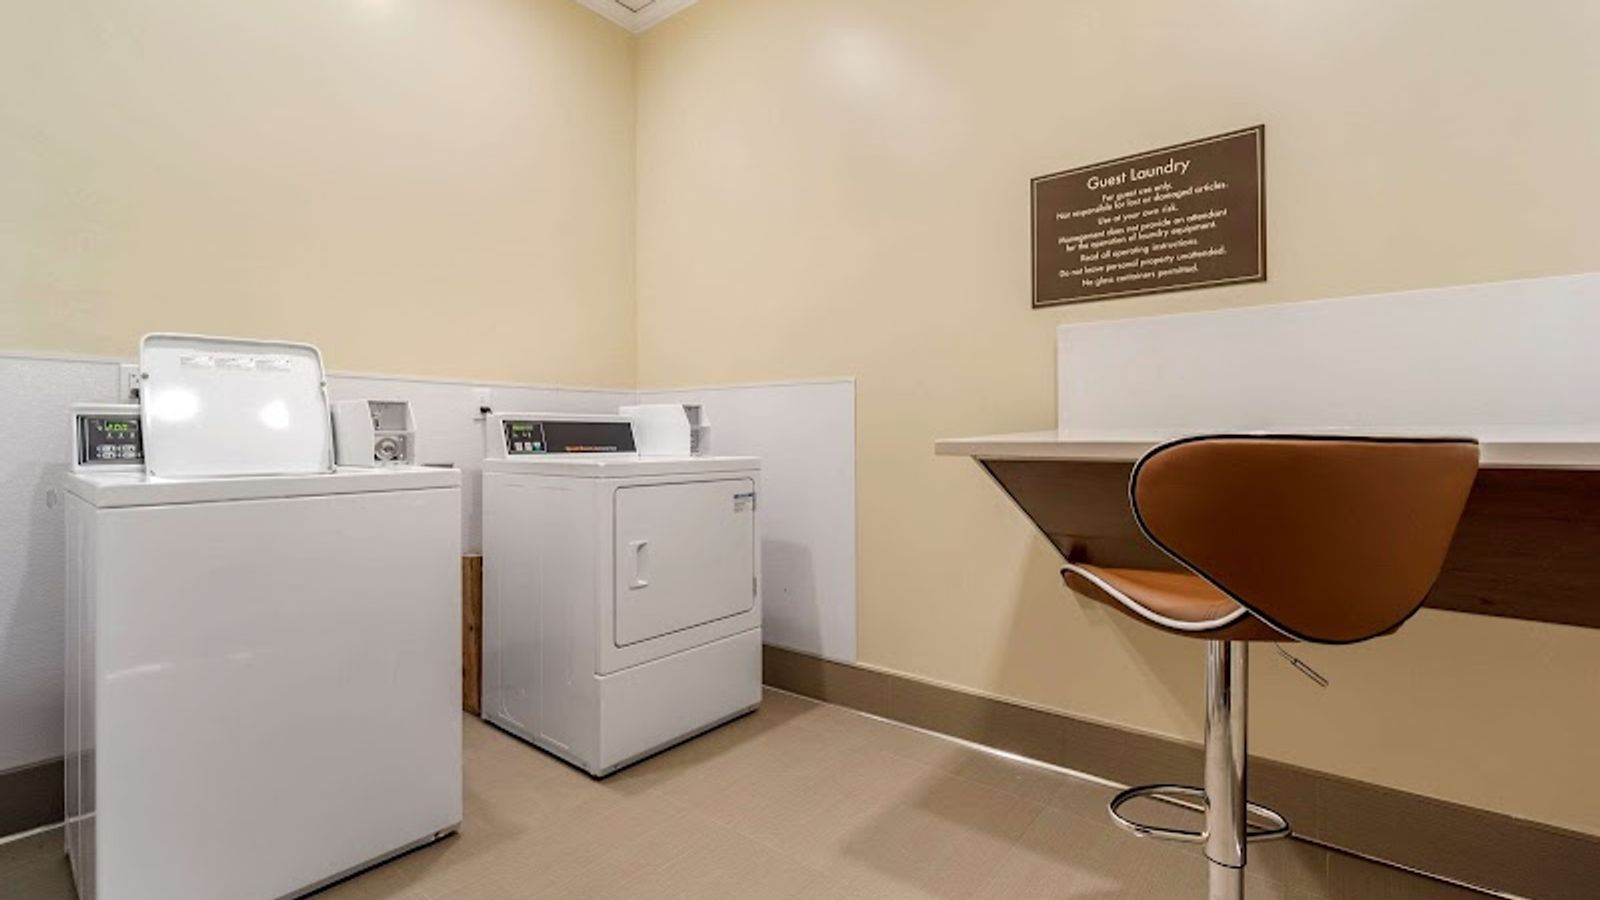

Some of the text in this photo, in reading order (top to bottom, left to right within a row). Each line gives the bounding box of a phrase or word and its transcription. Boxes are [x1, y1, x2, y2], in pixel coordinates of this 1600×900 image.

[1087, 158, 1191, 190] Guest Laundry
[1056, 181, 1229, 221] Not responsible for lost or damaged articles.
[1101, 194, 1115, 203] For
[1116, 189, 1138, 201] guest
[1138, 187, 1152, 195] use
[1058, 208, 1227, 244] Management does not provide an attendant
[1098, 202, 1179, 226] Use at your own risk.
[1065, 243, 1077, 252] for
[1077, 239, 1089, 250] the
[1090, 236, 1127, 249] operation
[1128, 232, 1138, 242] of
[1138, 228, 1169, 241] laundry
[1059, 245, 1226, 278] Do not leave personal property unattended.
[1080, 251, 1100, 262] Read
[1100, 249, 1112, 259] all
[1112, 246, 1149, 258] operating
[1082, 263, 1198, 287] No glass containers permitted.
